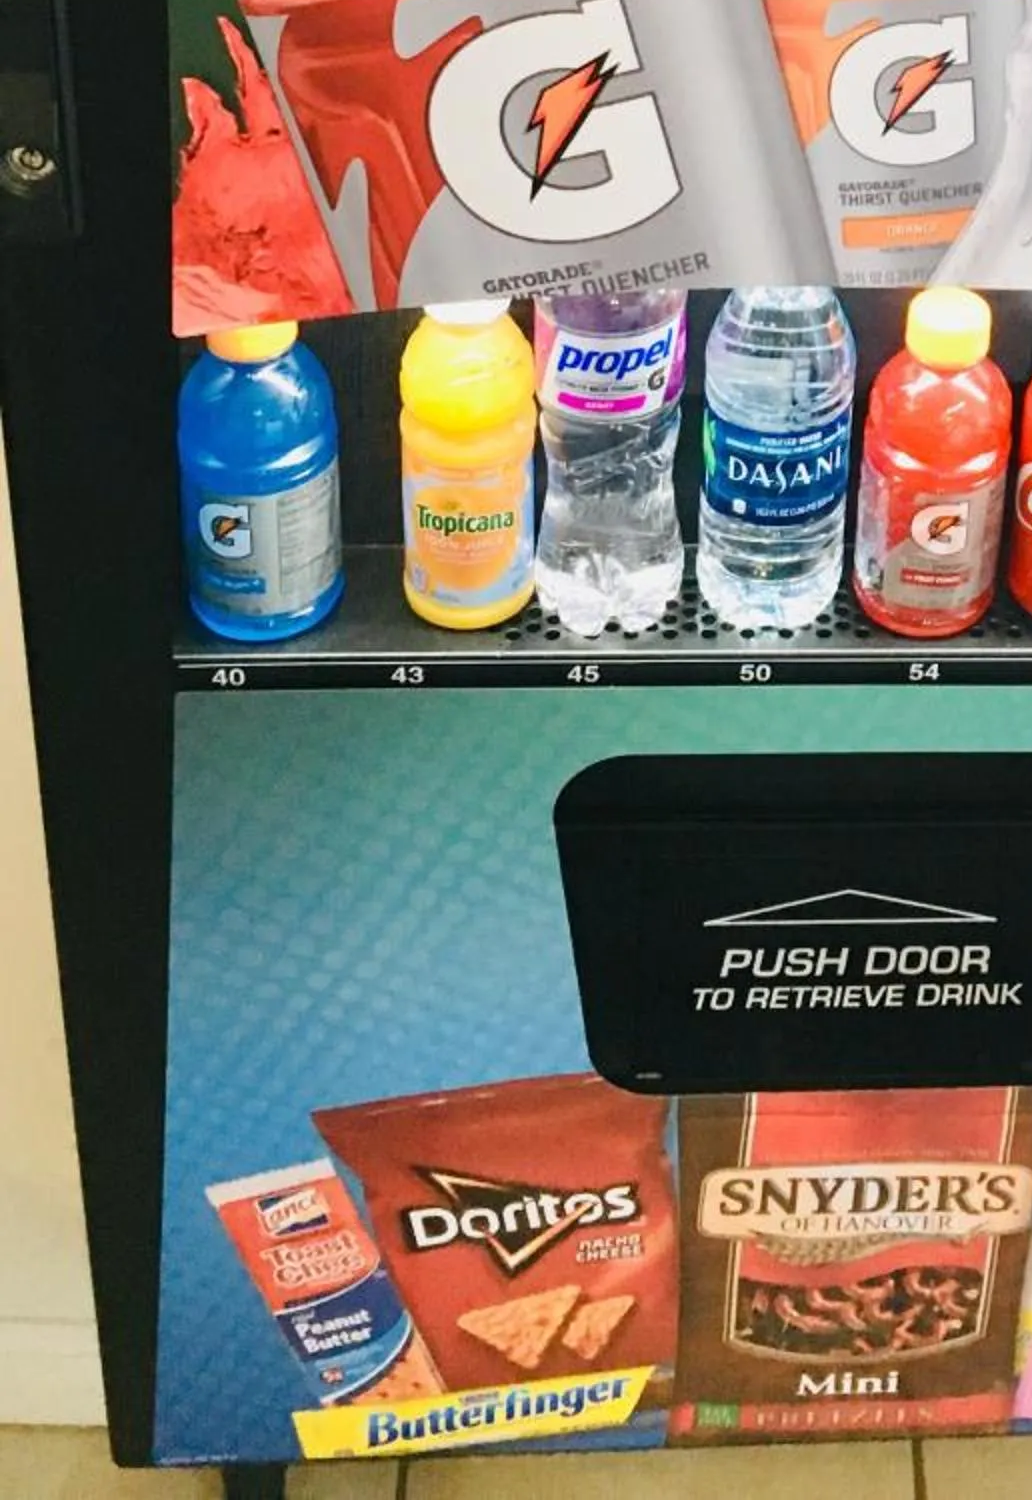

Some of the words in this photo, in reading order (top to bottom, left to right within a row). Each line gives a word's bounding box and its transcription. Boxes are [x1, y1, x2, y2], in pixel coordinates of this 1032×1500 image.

[828, 11, 978, 167] G
[839, 188, 894, 208] THIRST
[897, 181, 985, 206] QUENCHER
[483, 261, 593, 295] GATORADE
[581, 251, 711, 298] QUENCHER
[557, 327, 673, 381] propel
[728, 445, 841, 495] DASANI
[416, 502, 514, 537] Tropicana
[212, 668, 246, 687] 40
[391, 666, 424, 684] 43
[567, 665, 600, 683] 45
[739, 663, 772, 682] 50
[908, 663, 940, 681] 54
[719, 947, 850, 978] PUSH
[863, 945, 992, 976] DOOR
[693, 986, 735, 1011] TO
[745, 984, 906, 1010] RETRIEVE
[915, 982, 1024, 1008] DRINK
[719, 1170, 1018, 1216] SNYDER'S
[409, 1186, 637, 1249] Doritos
[781, 1217, 814, 1232] OF
[822, 1214, 954, 1233] HANOVER
[575, 1246, 645, 1264] CHEESE
[579, 1233, 642, 1252] NACHO
[296, 1308, 371, 1338] Peanut
[303, 1326, 372, 1354] Butter
[796, 1370, 900, 1396] Mini
[367, 1376, 632, 1449] Butterfinger
